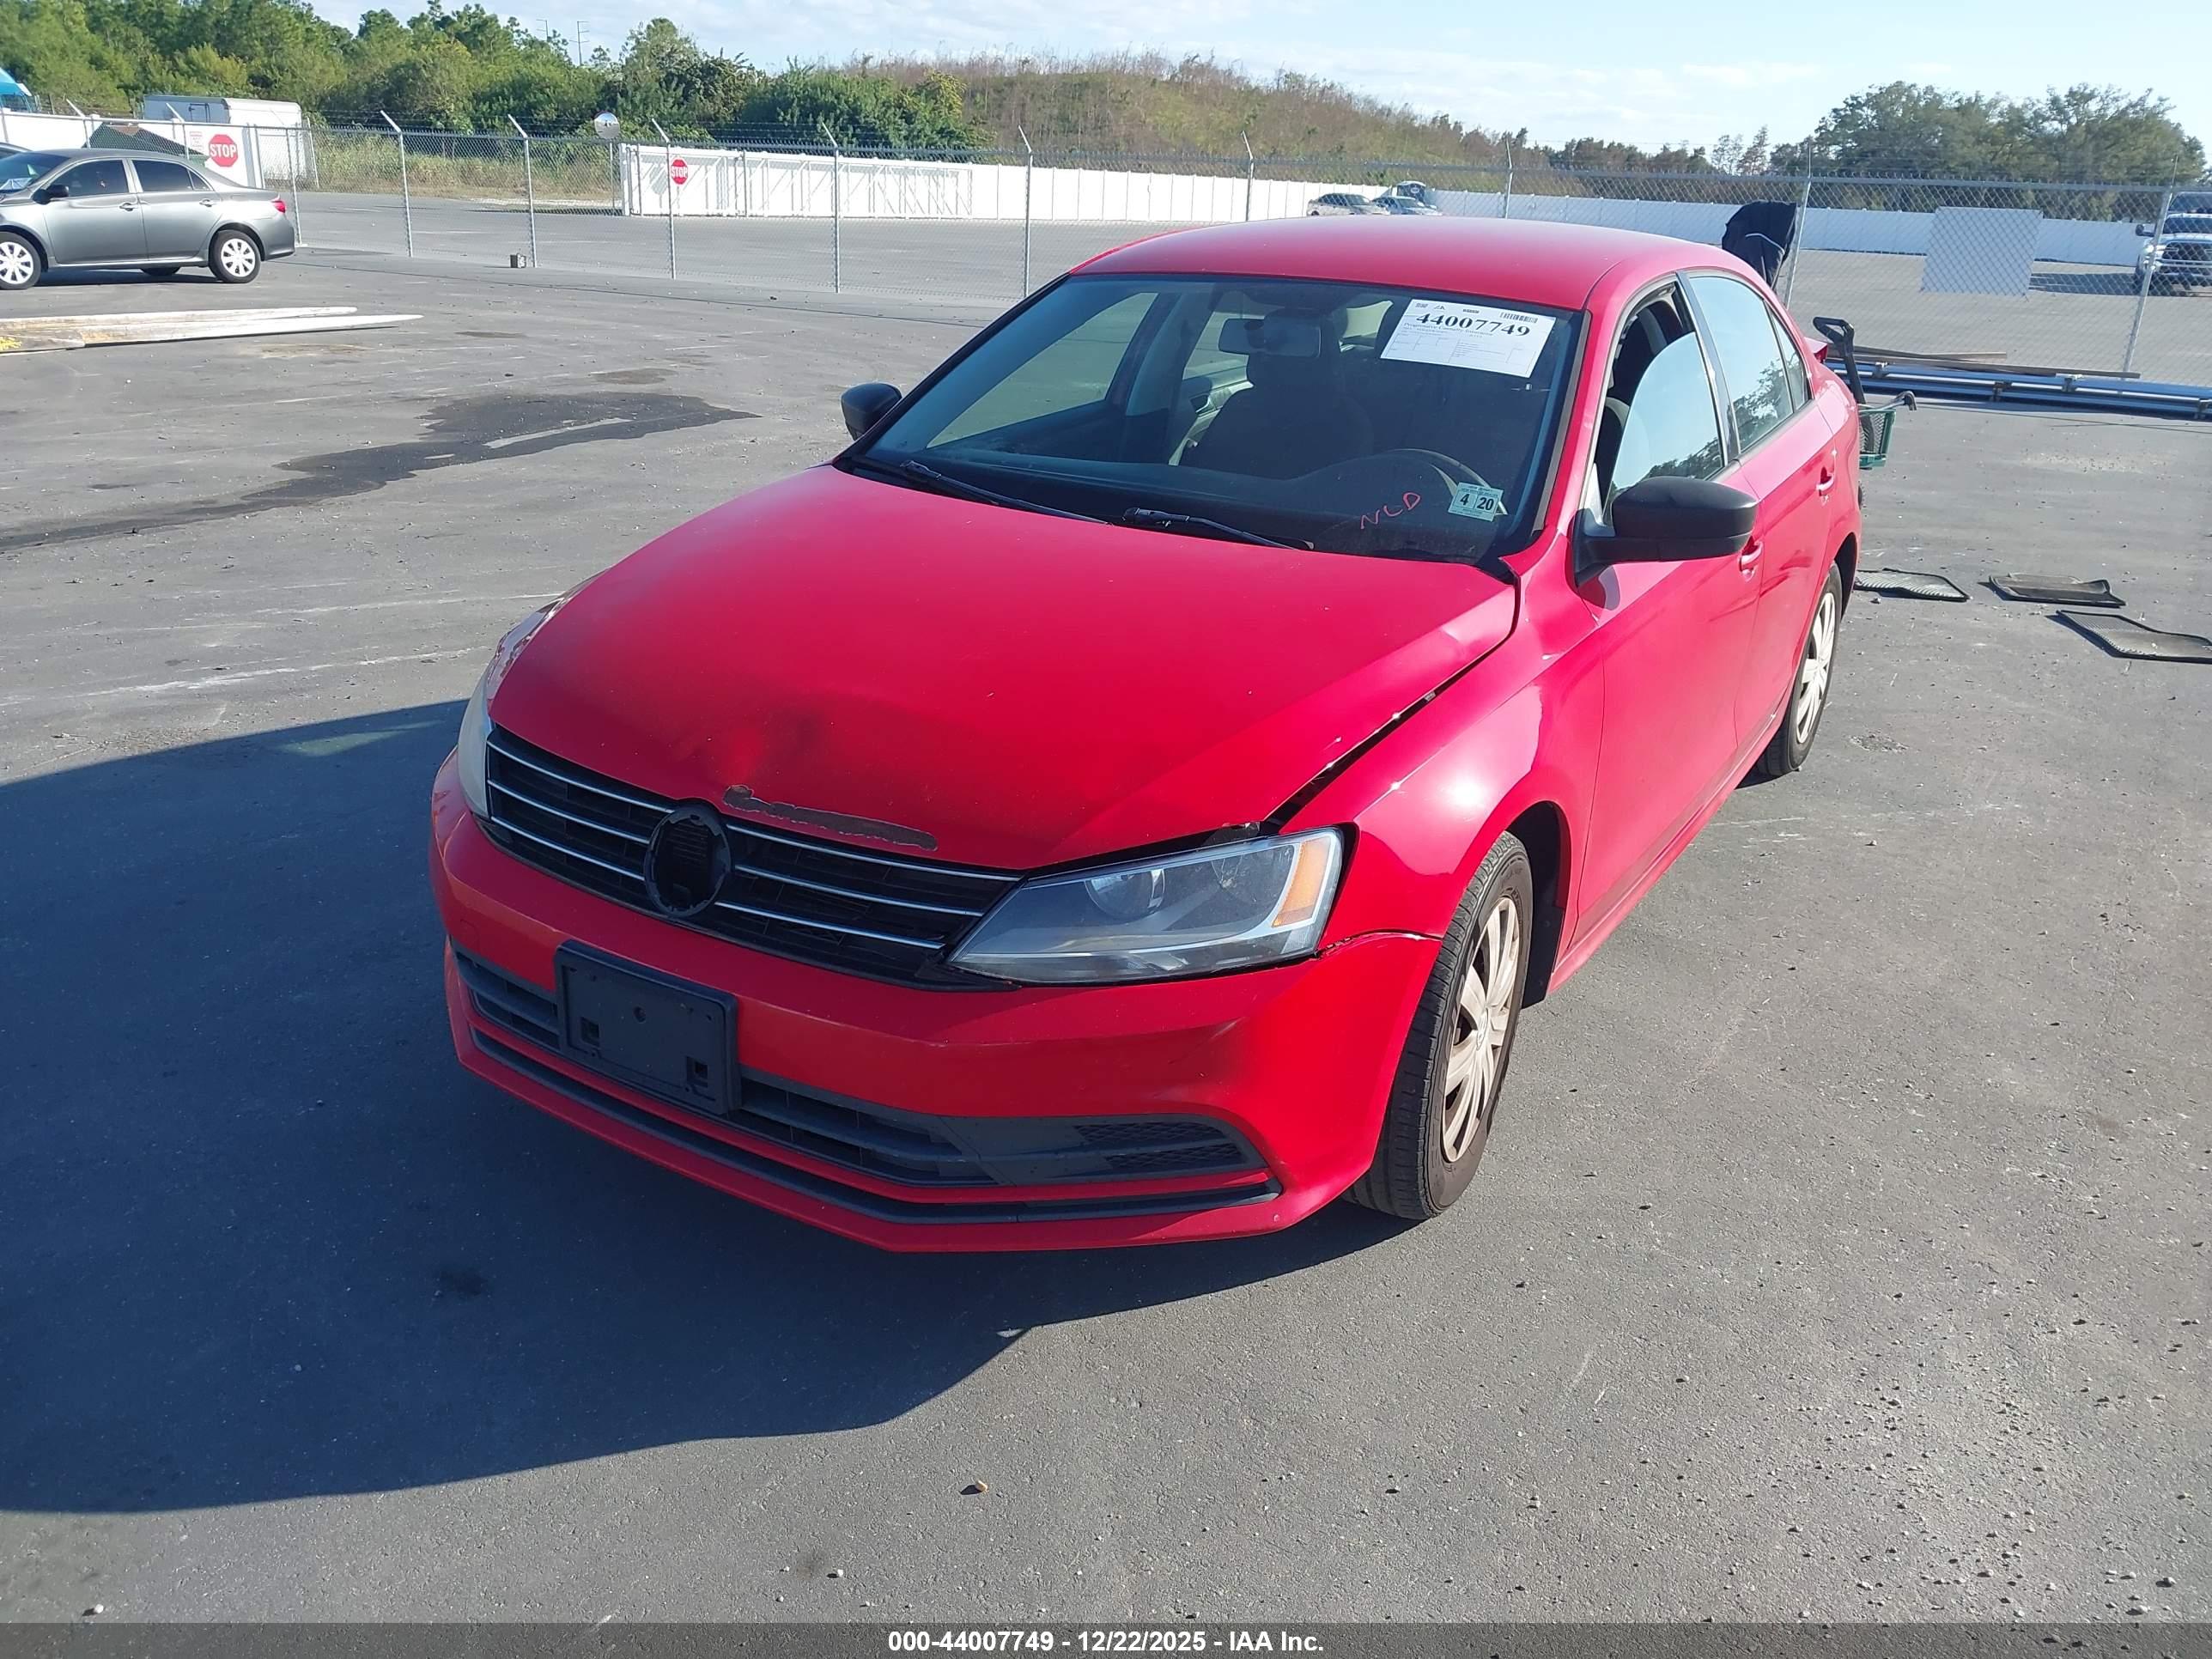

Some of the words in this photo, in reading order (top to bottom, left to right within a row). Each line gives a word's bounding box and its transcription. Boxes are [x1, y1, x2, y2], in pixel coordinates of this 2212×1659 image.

[210, 143, 236, 158] STOP
[672, 167, 688, 178] STOP
[1416, 313, 1530, 337] 44007749
[1460, 494, 1470, 506] 4
[1477, 497, 1494, 511] 20
